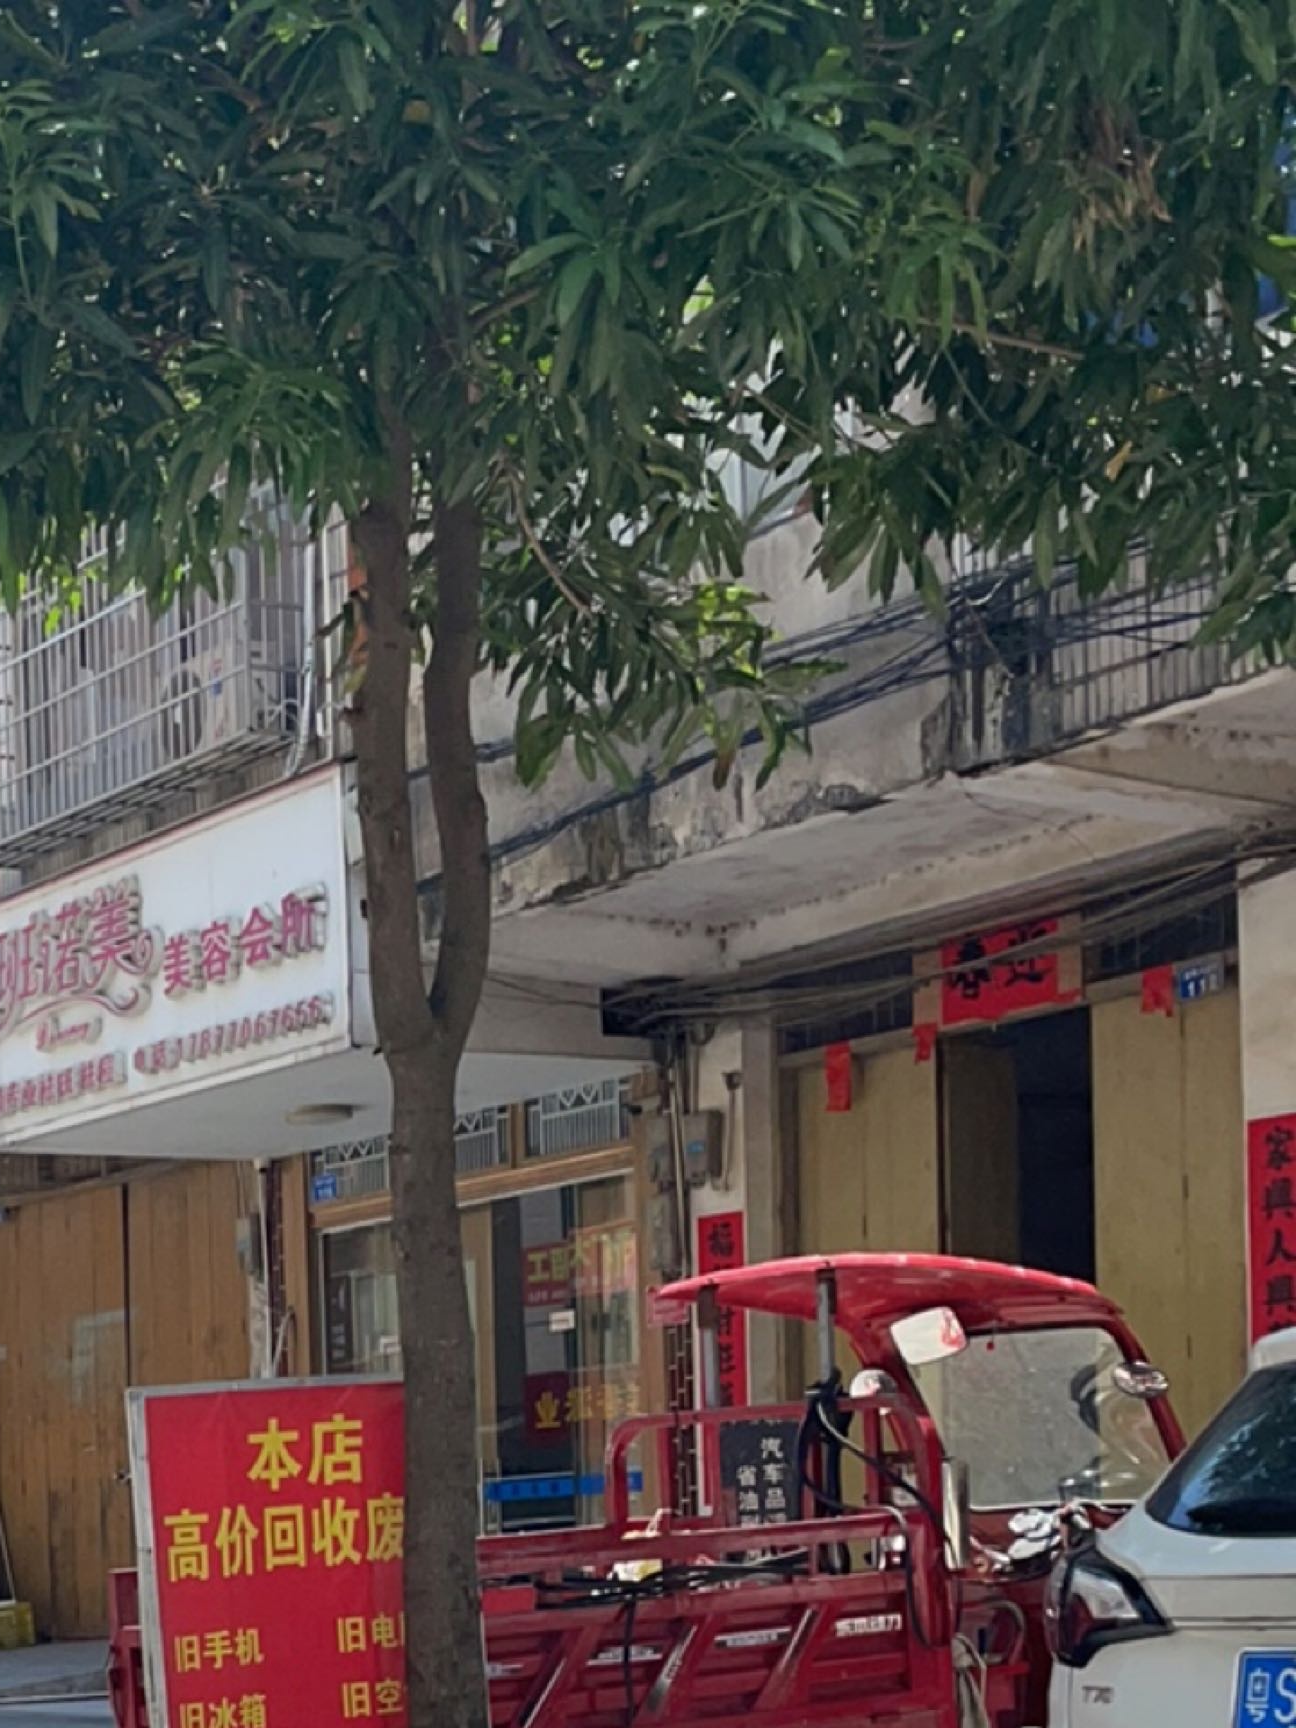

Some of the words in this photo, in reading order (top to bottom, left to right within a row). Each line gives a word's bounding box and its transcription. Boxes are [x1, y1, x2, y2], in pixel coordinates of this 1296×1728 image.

[164, 892, 320, 996] 美容会所
[246, 1412, 363, 1491] 本店
[163, 1491, 405, 1582] 高价回收废
[174, 1627, 265, 1673] 旧手机
[336, 1611, 405, 1654] 旧电
